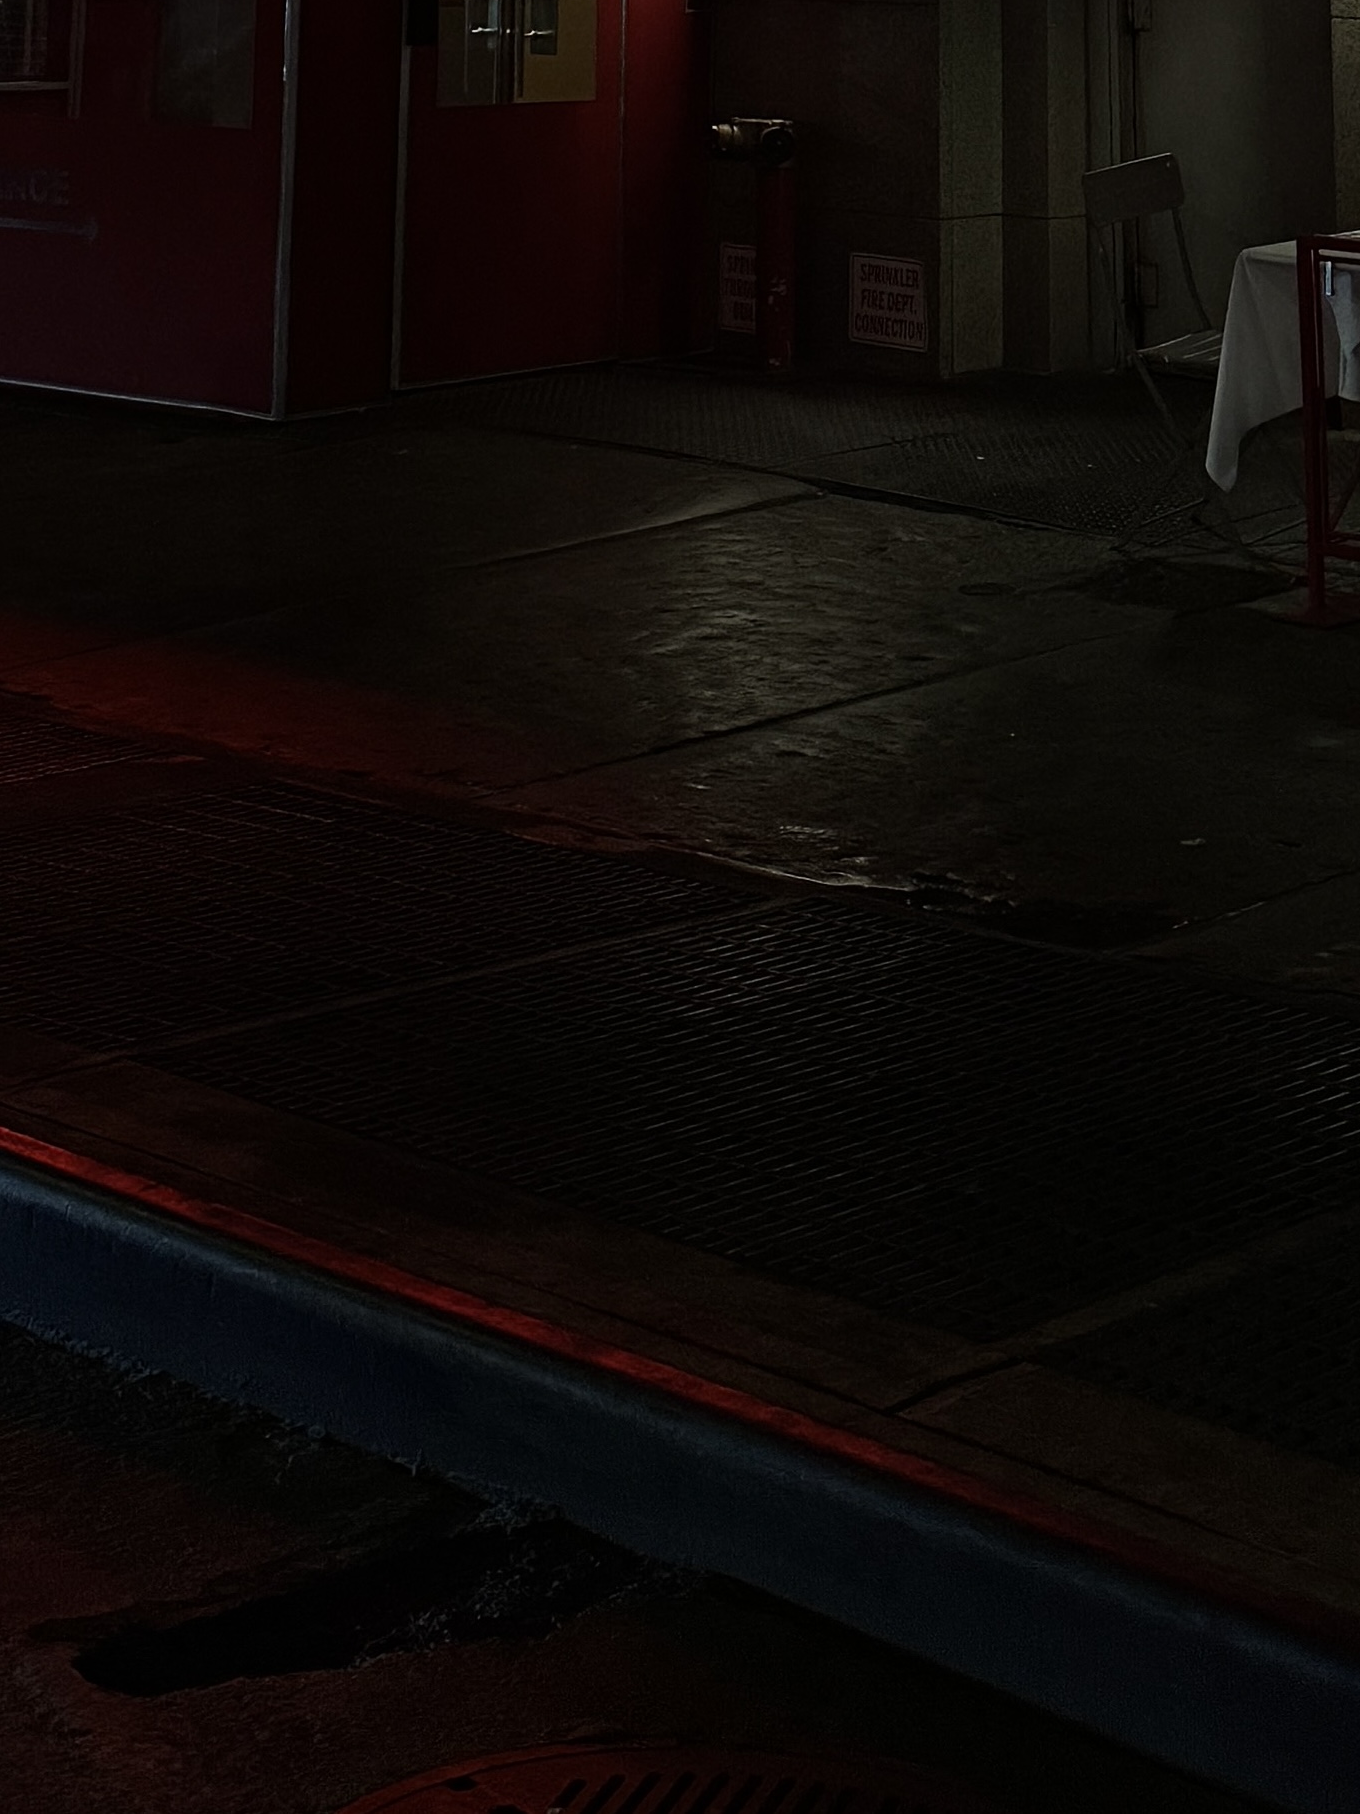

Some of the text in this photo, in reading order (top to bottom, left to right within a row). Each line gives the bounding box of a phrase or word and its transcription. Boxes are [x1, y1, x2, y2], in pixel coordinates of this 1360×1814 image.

[860, 263, 919, 290] SPRINKLER
[861, 288, 918, 315] FIRE DEPT.
[854, 312, 924, 341] CONNECTION
